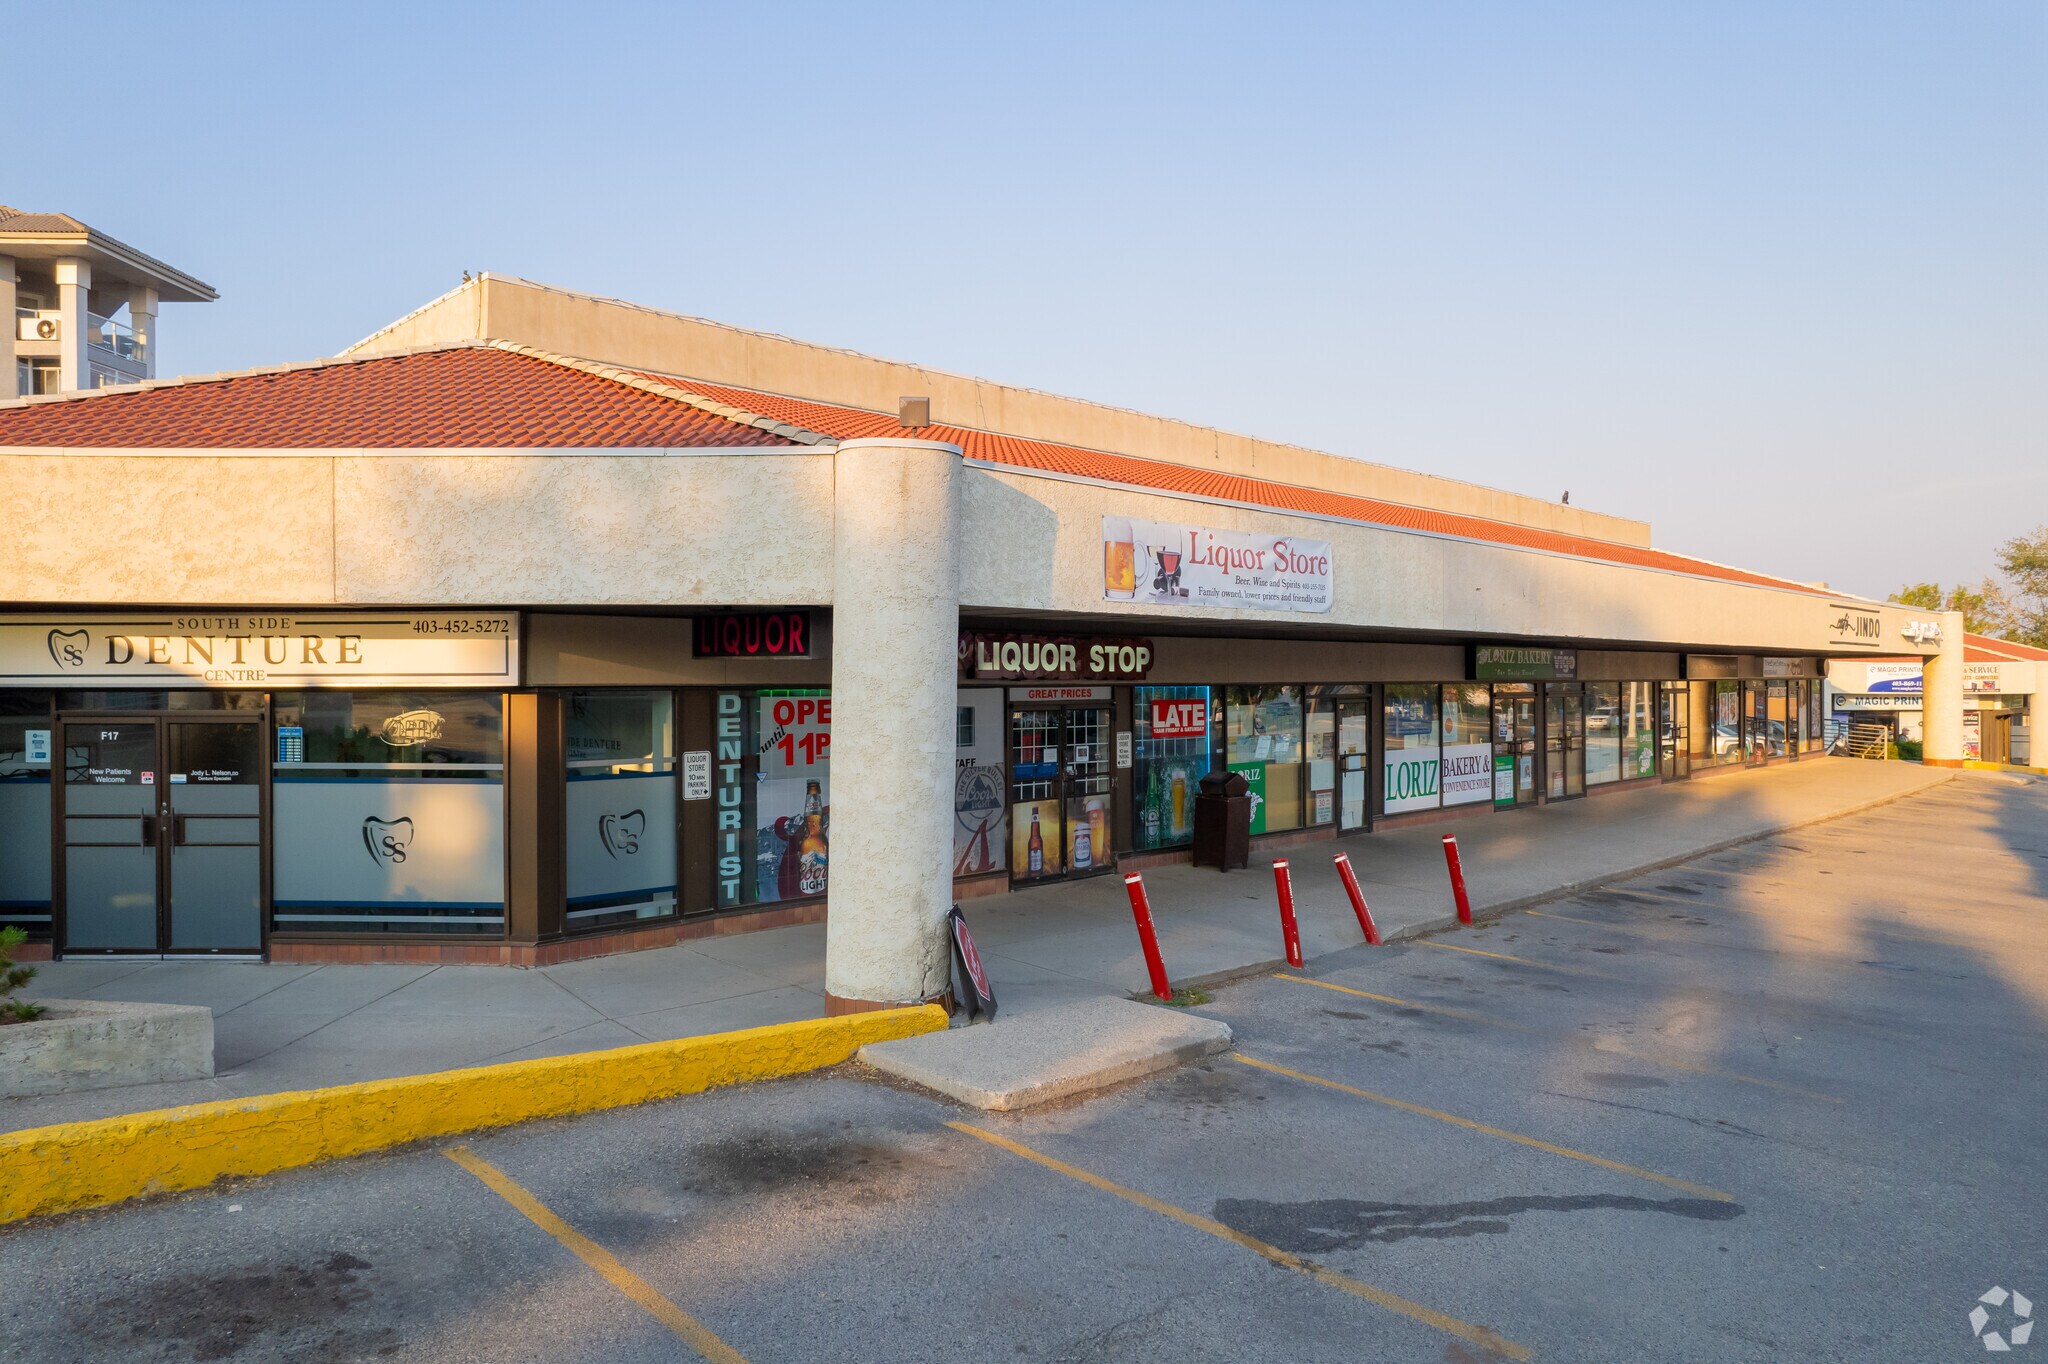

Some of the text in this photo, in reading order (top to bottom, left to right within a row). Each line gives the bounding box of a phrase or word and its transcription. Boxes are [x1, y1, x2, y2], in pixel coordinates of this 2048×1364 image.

[1189, 531, 1328, 577] Liquor Store
[1252, 577, 1268, 587] Wine
[1269, 579, 1280, 588] and
[1281, 579, 1301, 591] Spirits
[1198, 587, 1219, 598] Family
[1244, 591, 1260, 600] lower
[1262, 593, 1279, 602] prices
[1281, 593, 1291, 602] and
[1293, 594, 1313, 605] friendly
[1314, 595, 1326, 604] staff
[177, 617, 290, 629] SOUTH SIDE
[413, 619, 510, 633] 403-452-5272
[1856, 616, 1880, 639] JINDO
[701, 614, 805, 656] LIQUOR
[105, 634, 363, 666] DENTURE
[977, 641, 1077, 673] LIQUOR
[1089, 644, 1151, 673] STOP
[1487, 648, 1552, 664] LORIZ BAKERY
[204, 669, 265, 682] CENTRE
[1028, 688, 1092, 699] GREAT PRICES
[1855, 696, 1890, 706] MAGIC
[773, 700, 831, 725] OPE
[1153, 703, 1205, 728] LATE
[101, 731, 119, 740] F17
[583, 737, 622, 750] DENTURE
[760, 724, 786, 754] until
[687, 755, 706, 763] LIQUOR
[1443, 756, 1482, 777] BAKERY
[1483, 755, 1490, 773] &
[688, 764, 706, 772] STORE
[688, 781, 707, 789] PARKING
[958, 766, 1003, 796] THE SILVER BULLET
[1386, 760, 1439, 800] LORIZ
[1443, 779, 1476, 794] CONVENIENCE
[1476, 778, 1490, 790] STORE
[719, 694, 742, 899] DENTURIST
